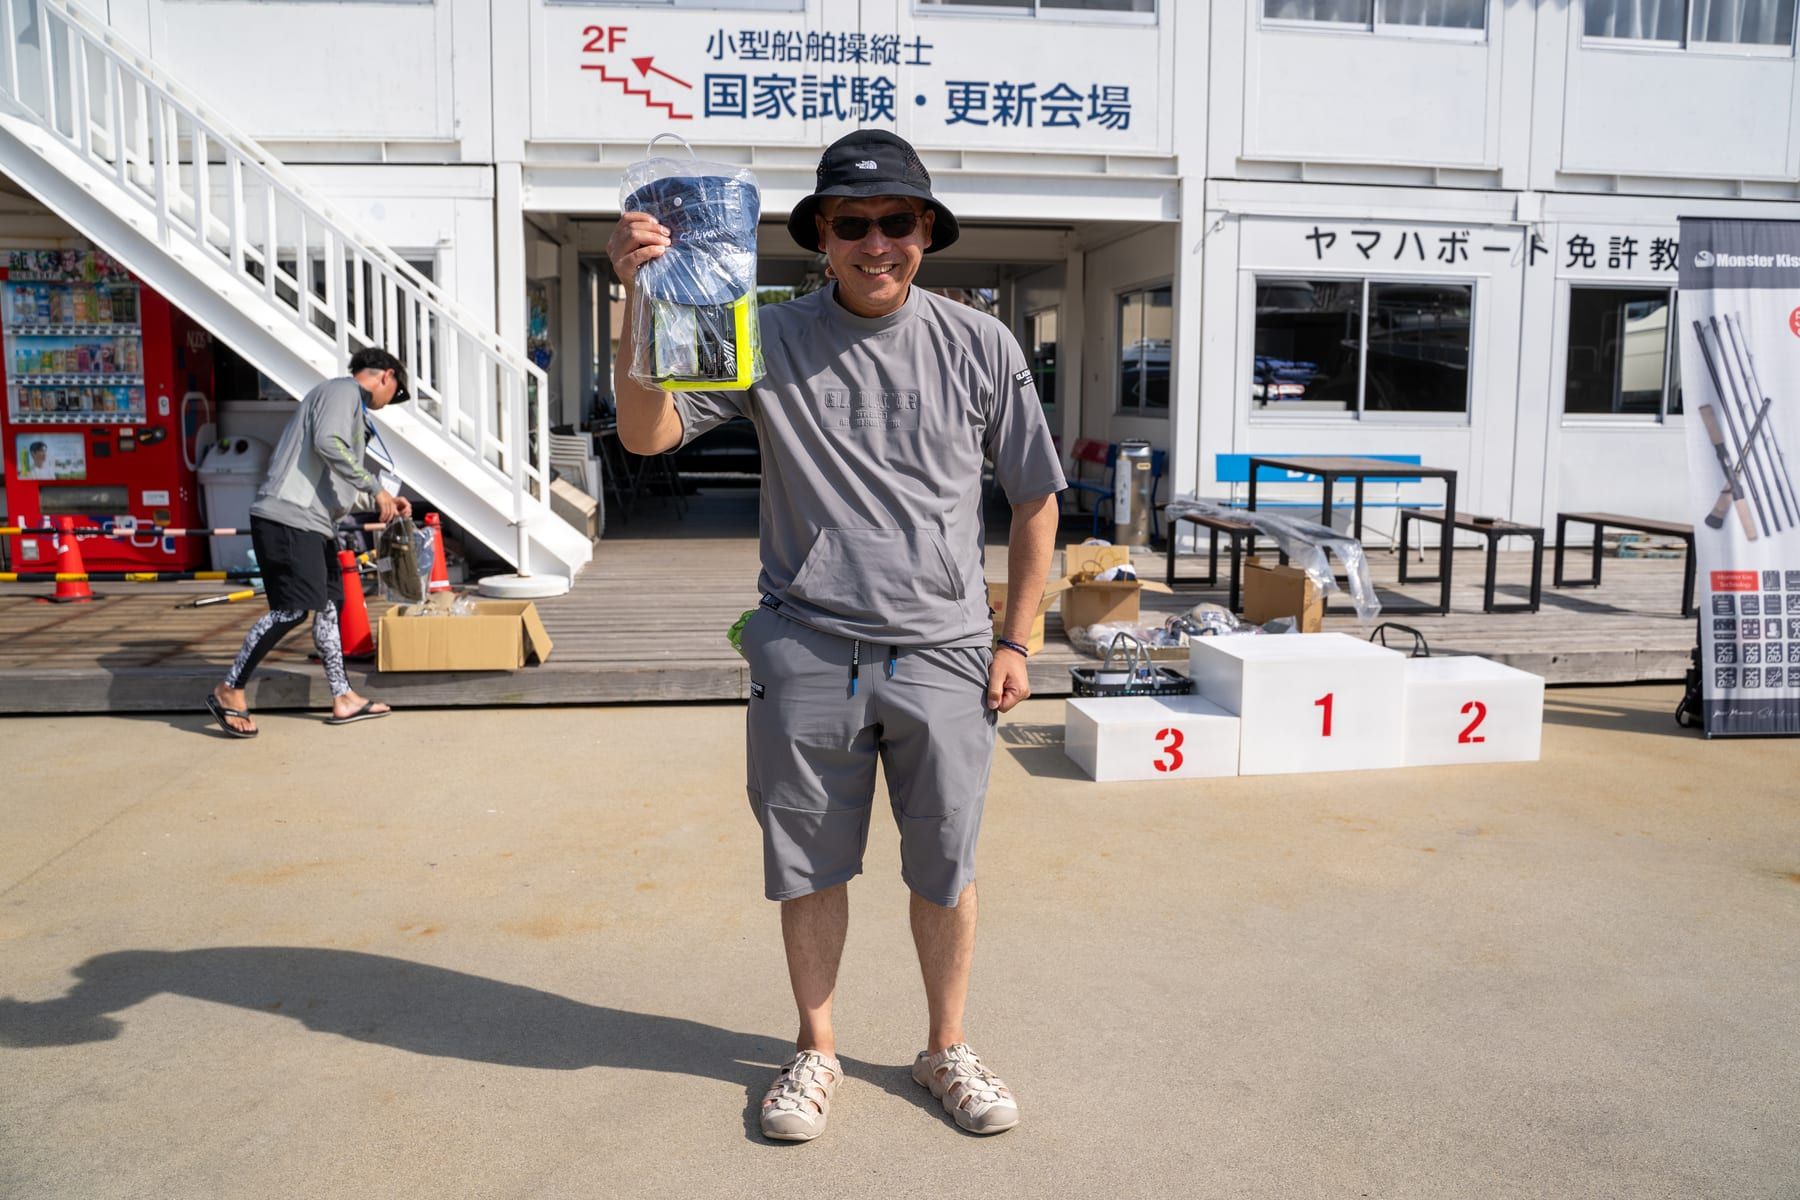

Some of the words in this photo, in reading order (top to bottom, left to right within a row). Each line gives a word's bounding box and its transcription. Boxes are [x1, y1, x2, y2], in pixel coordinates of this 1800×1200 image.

[582, 25, 628, 53] 2F
[706, 28, 934, 66] 小型船舶操縦士
[1716, 253, 1774, 267] Monster
[1314, 693, 1334, 736] 1
[1458, 701, 1487, 743] 2
[1153, 728, 1184, 772] 3
